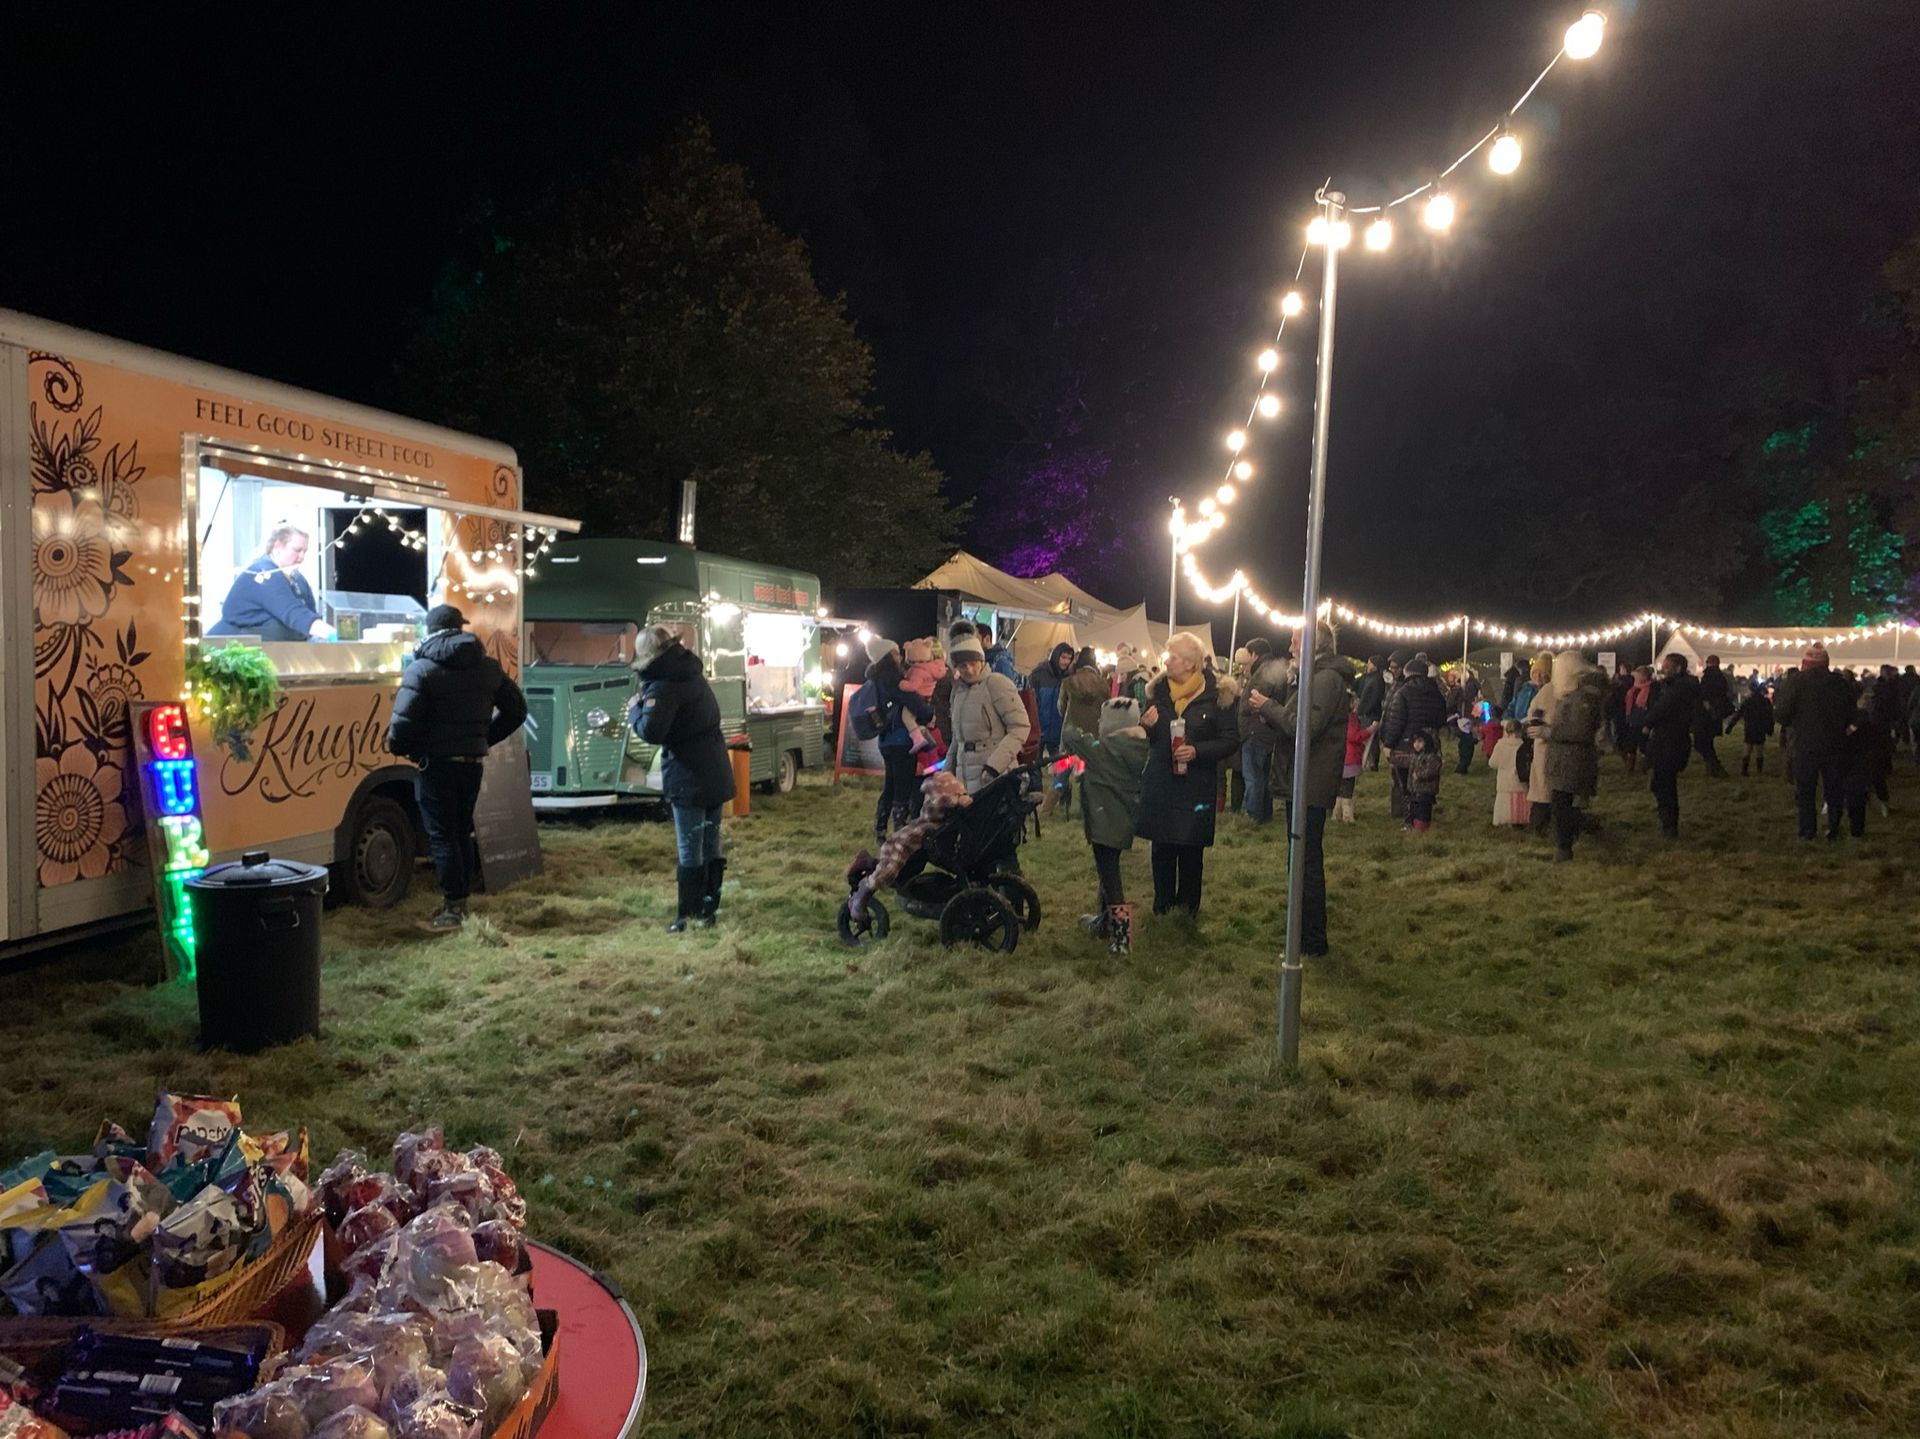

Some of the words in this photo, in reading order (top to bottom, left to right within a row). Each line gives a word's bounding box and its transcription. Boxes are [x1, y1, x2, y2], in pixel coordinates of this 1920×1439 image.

[196, 398, 250, 429] FEEL
[257, 413, 314, 442] GOOD
[322, 428, 387, 459] STREET
[393, 445, 433, 468] FOOD
